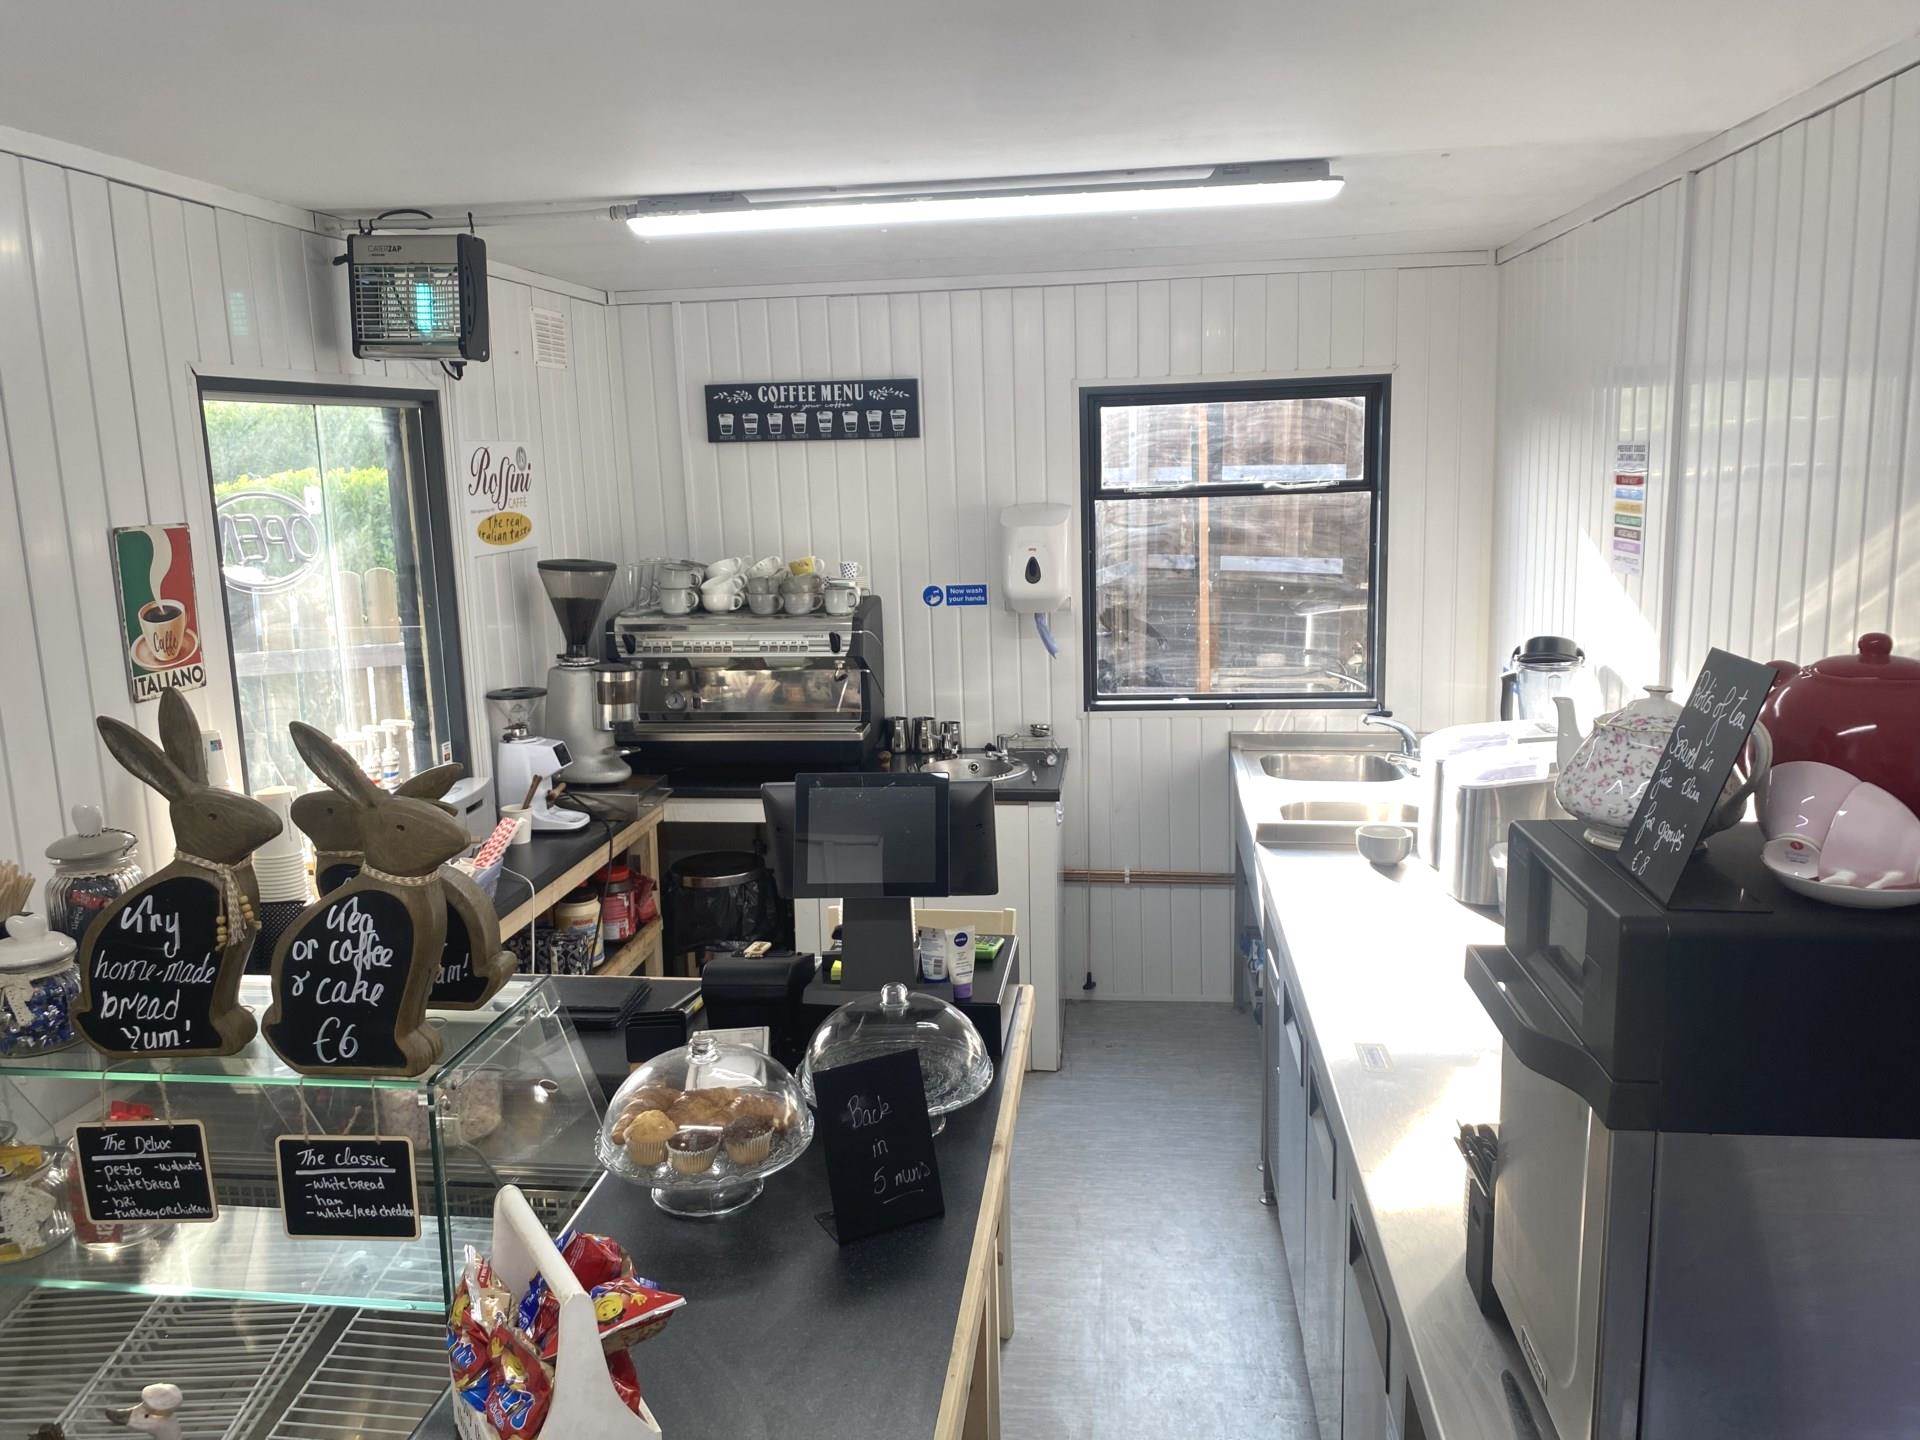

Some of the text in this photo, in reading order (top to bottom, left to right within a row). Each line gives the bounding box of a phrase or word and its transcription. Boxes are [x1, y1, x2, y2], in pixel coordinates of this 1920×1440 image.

[757, 383, 864, 404] COFFEE MENU
[801, 402, 822, 411] your
[949, 594, 985, 603] your hands
[134, 665, 204, 697] ITALIANO
[1706, 686, 1737, 747] of
[1729, 689, 1749, 730] tea
[1699, 751, 1714, 773] in
[94, 949, 216, 985] home-made
[292, 932, 394, 971] or coffee
[315, 968, 385, 1007] cake
[100, 988, 181, 1021] bread
[120, 1019, 192, 1053] Yum!
[847, 1094, 893, 1129] Back
[100, 1132, 126, 1152] The
[296, 1148, 327, 1166] The
[872, 1138, 889, 1158] in
[873, 1165, 886, 1195] 5
